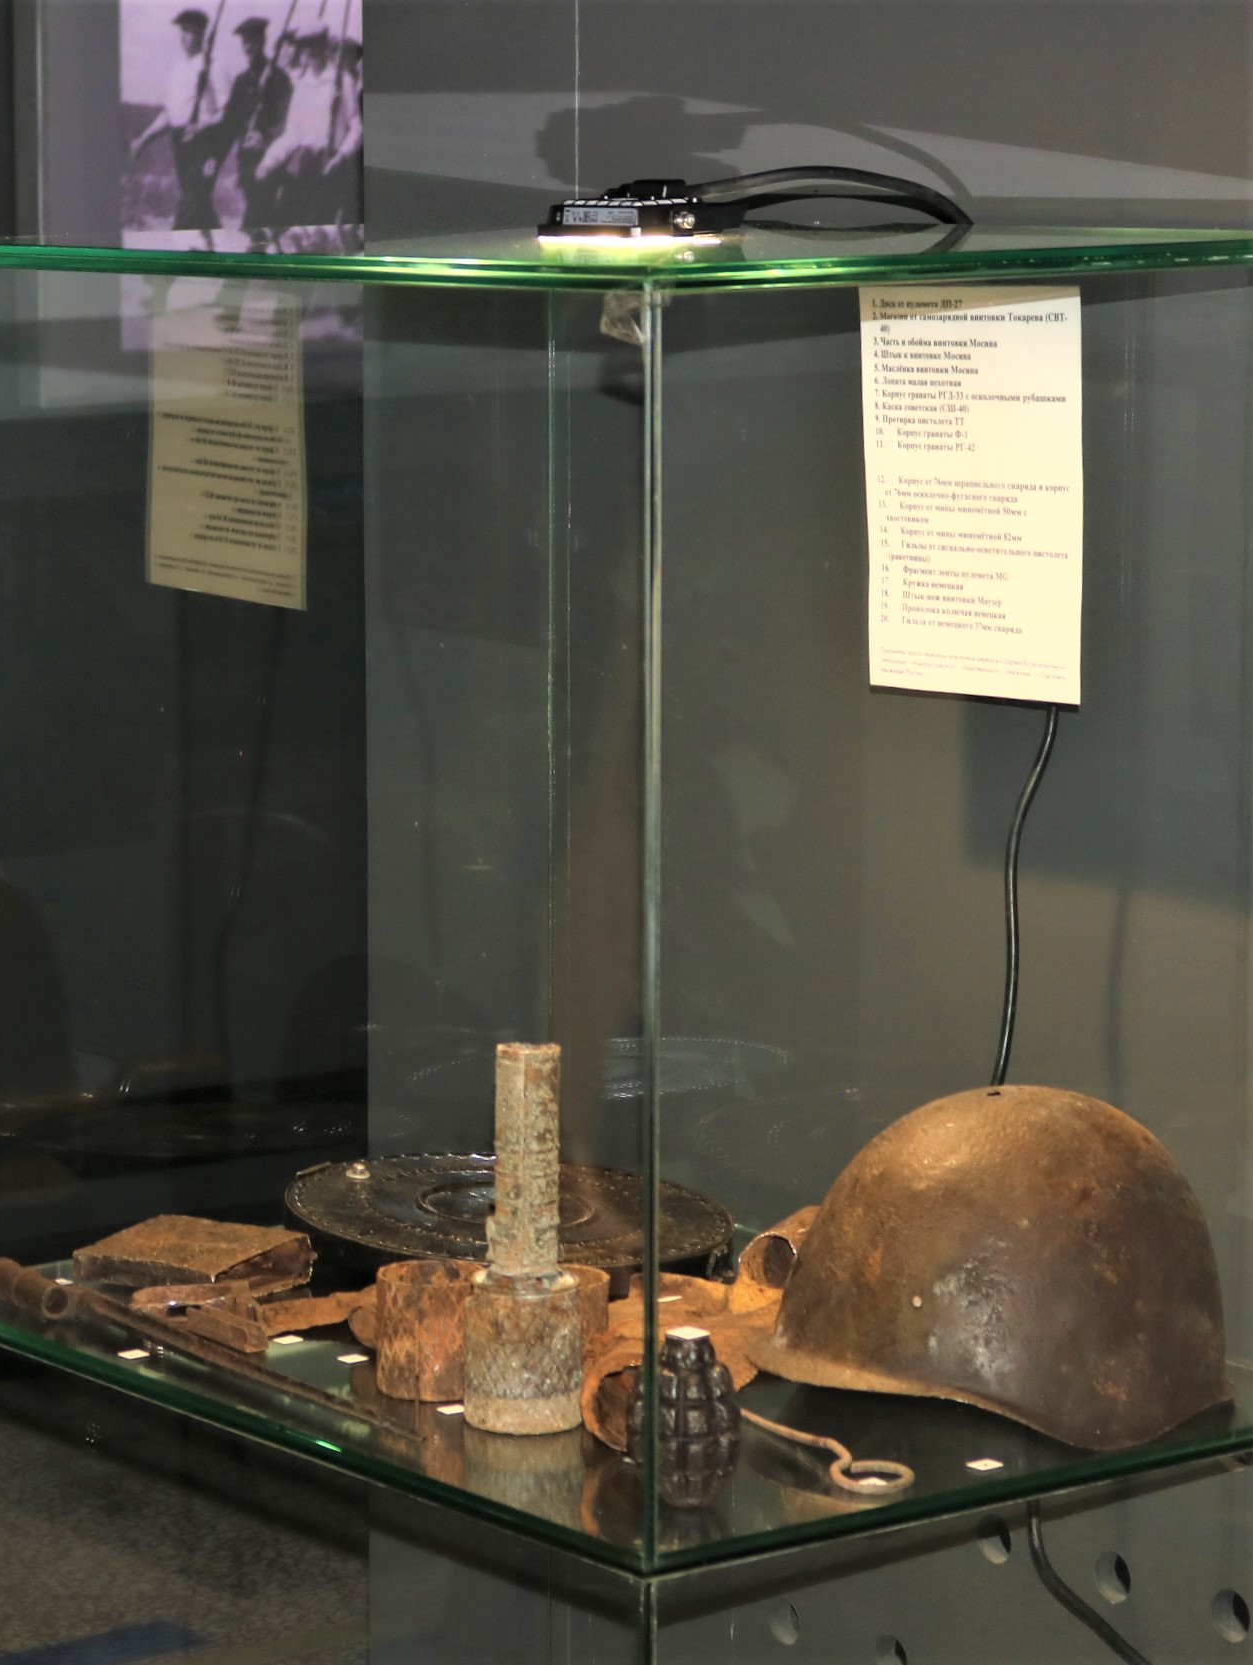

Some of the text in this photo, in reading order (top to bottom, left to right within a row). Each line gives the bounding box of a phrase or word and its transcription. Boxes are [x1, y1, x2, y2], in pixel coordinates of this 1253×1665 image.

[872, 299, 878, 308] 1.
[920, 313, 967, 323] самозарядной
[970, 313, 1005, 322] винтовки
[1008, 313, 1043, 323] Токарева
[1045, 313, 1067, 323] (СВТ-
[880, 325, 890, 334] 40)
[874, 337, 879, 346] 3.
[881, 337, 899, 346] Часть
[908, 338, 931, 346] обойма
[970, 338, 997, 348] Мосина
[881, 350, 902, 358] Штык
[944, 351, 971, 360] Мосина
[874, 364, 880, 372] 5.
[951, 366, 978, 374] Мосина
[875, 389, 880, 397] 7.
[882, 389, 906, 399] Корпус
[908, 391, 936, 400] гранаты
[938, 390, 963, 400] РГД-33
[1023, 393, 1066, 404] рубашками
[882, 402, 902, 410] Каска
[939, 404, 969, 413] (СШ-40)
[954, 417, 964, 425] ТТ
[897, 428, 921, 438] Корпус
[955, 430, 968, 439] Ф-1
[898, 440, 921, 450] Корпус
[898, 476, 923, 487] Корпус
[1008, 483, 1036, 492] снаряда
[1046, 485, 1070, 494] корпус
[900, 501, 924, 512] Корпус
[1003, 507, 1021, 516] 50мм
[901, 526, 925, 537] Корпус
[881, 539, 889, 547] 15.
[903, 578, 929, 588] Кружка
